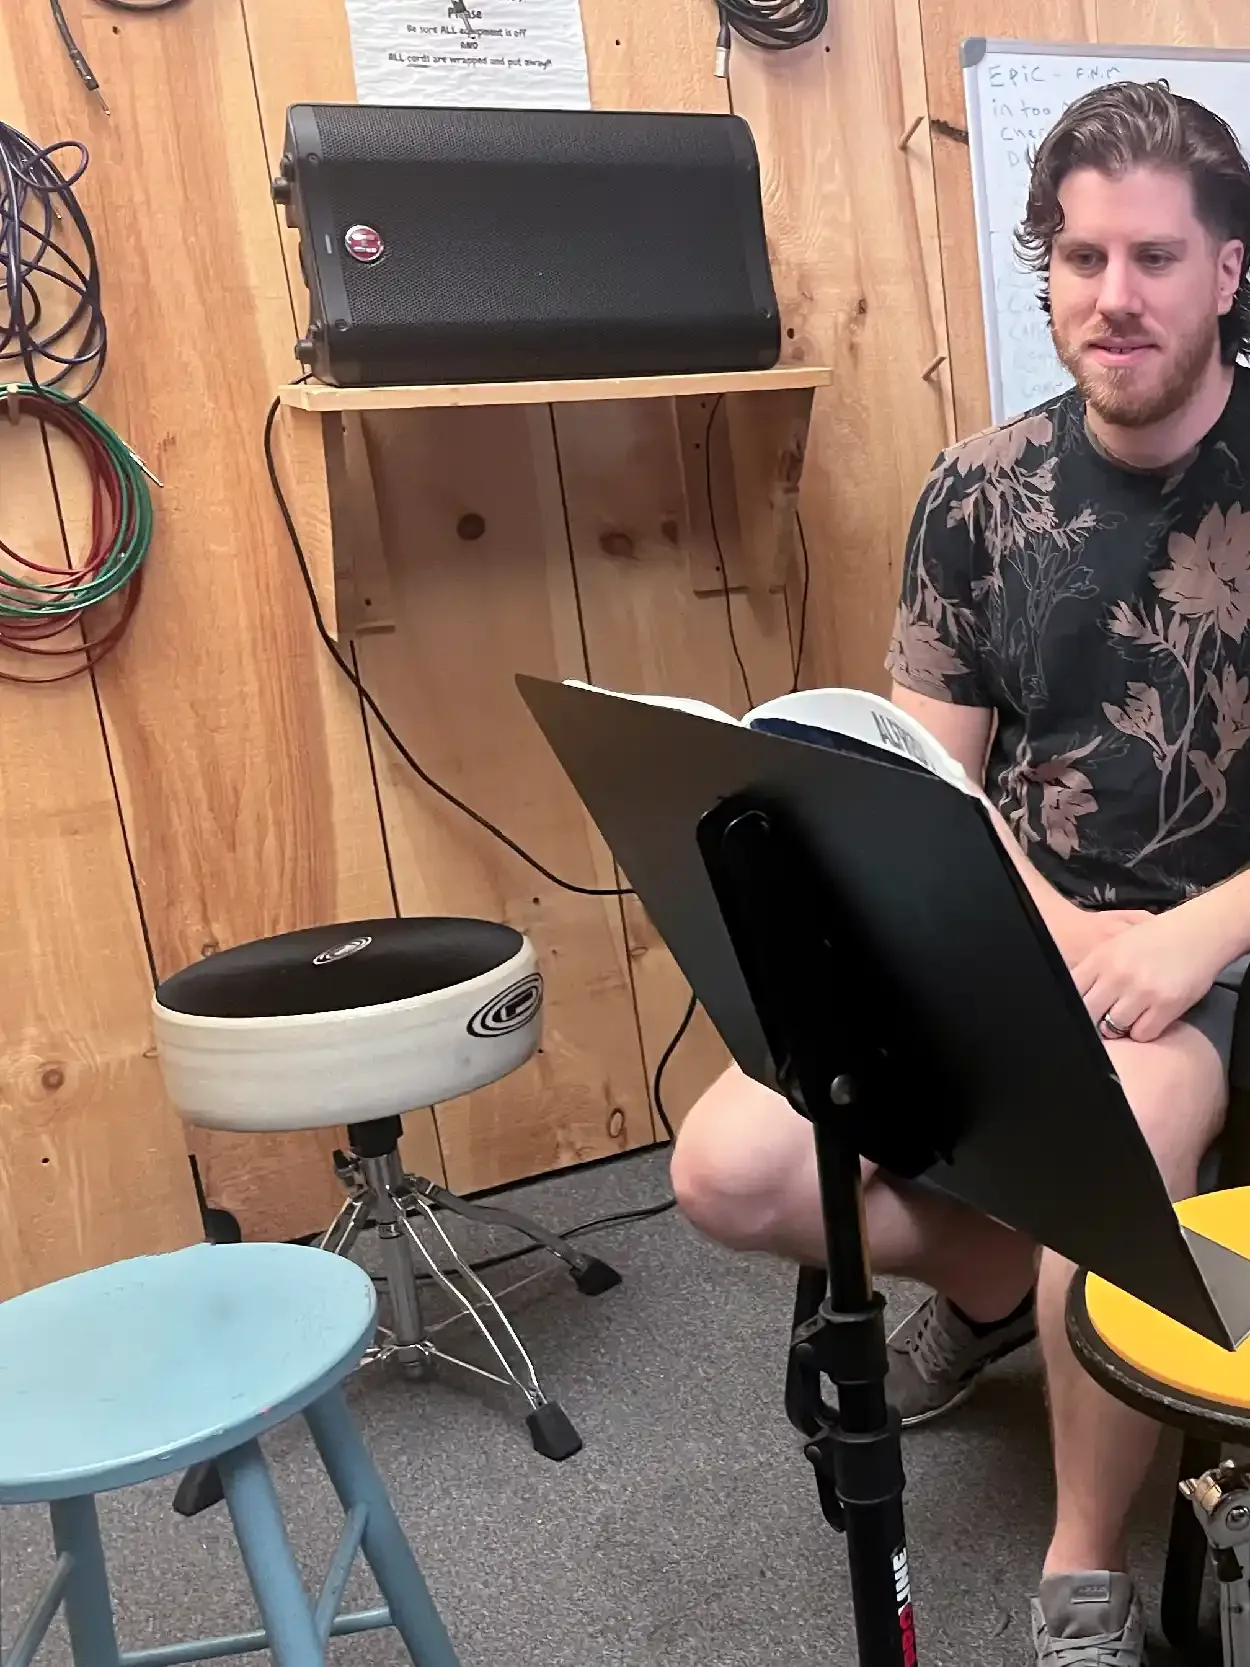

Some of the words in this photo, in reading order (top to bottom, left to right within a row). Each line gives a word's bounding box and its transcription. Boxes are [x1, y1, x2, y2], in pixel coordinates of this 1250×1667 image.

[420, 26, 438, 34] sure
[440, 25, 457, 34] ALL
[505, 28, 512, 37] is
[514, 28, 527, 37] off
[460, 41, 478, 49] AND
[388, 52, 404, 62] ALL
[407, 53, 430, 62] cords
[449, 56, 488, 67] wrapped
[490, 57, 505, 65] and
[507, 58, 522, 68] put
[1020, 100, 1051, 117] too
